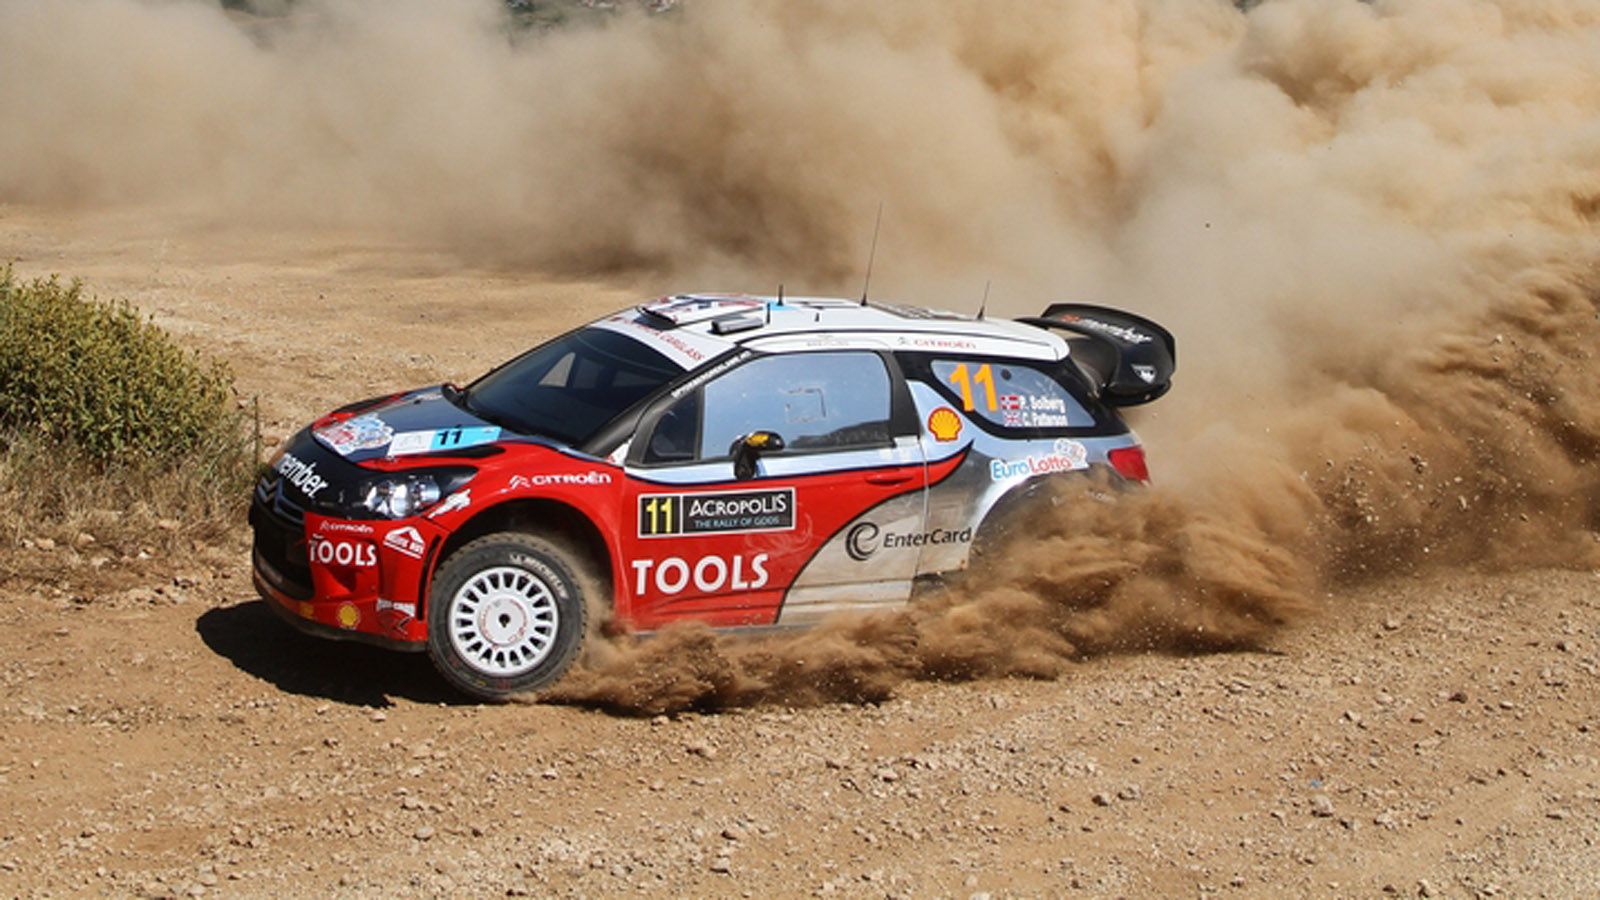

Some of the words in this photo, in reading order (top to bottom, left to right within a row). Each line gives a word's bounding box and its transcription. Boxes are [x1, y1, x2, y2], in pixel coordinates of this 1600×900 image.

[949, 361, 997, 413] 11
[436, 430, 462, 445] 11
[646, 498, 673, 534] 11
[688, 493, 787, 517] ACROPOLIS
[694, 518, 711, 528] THE
[714, 518, 738, 528] RALLY
[741, 517, 753, 526] OF
[755, 515, 780, 526] GODS
[883, 526, 972, 549] EnterCard
[309, 539, 378, 566] TOOLS
[632, 552, 769, 596] TOOLS
